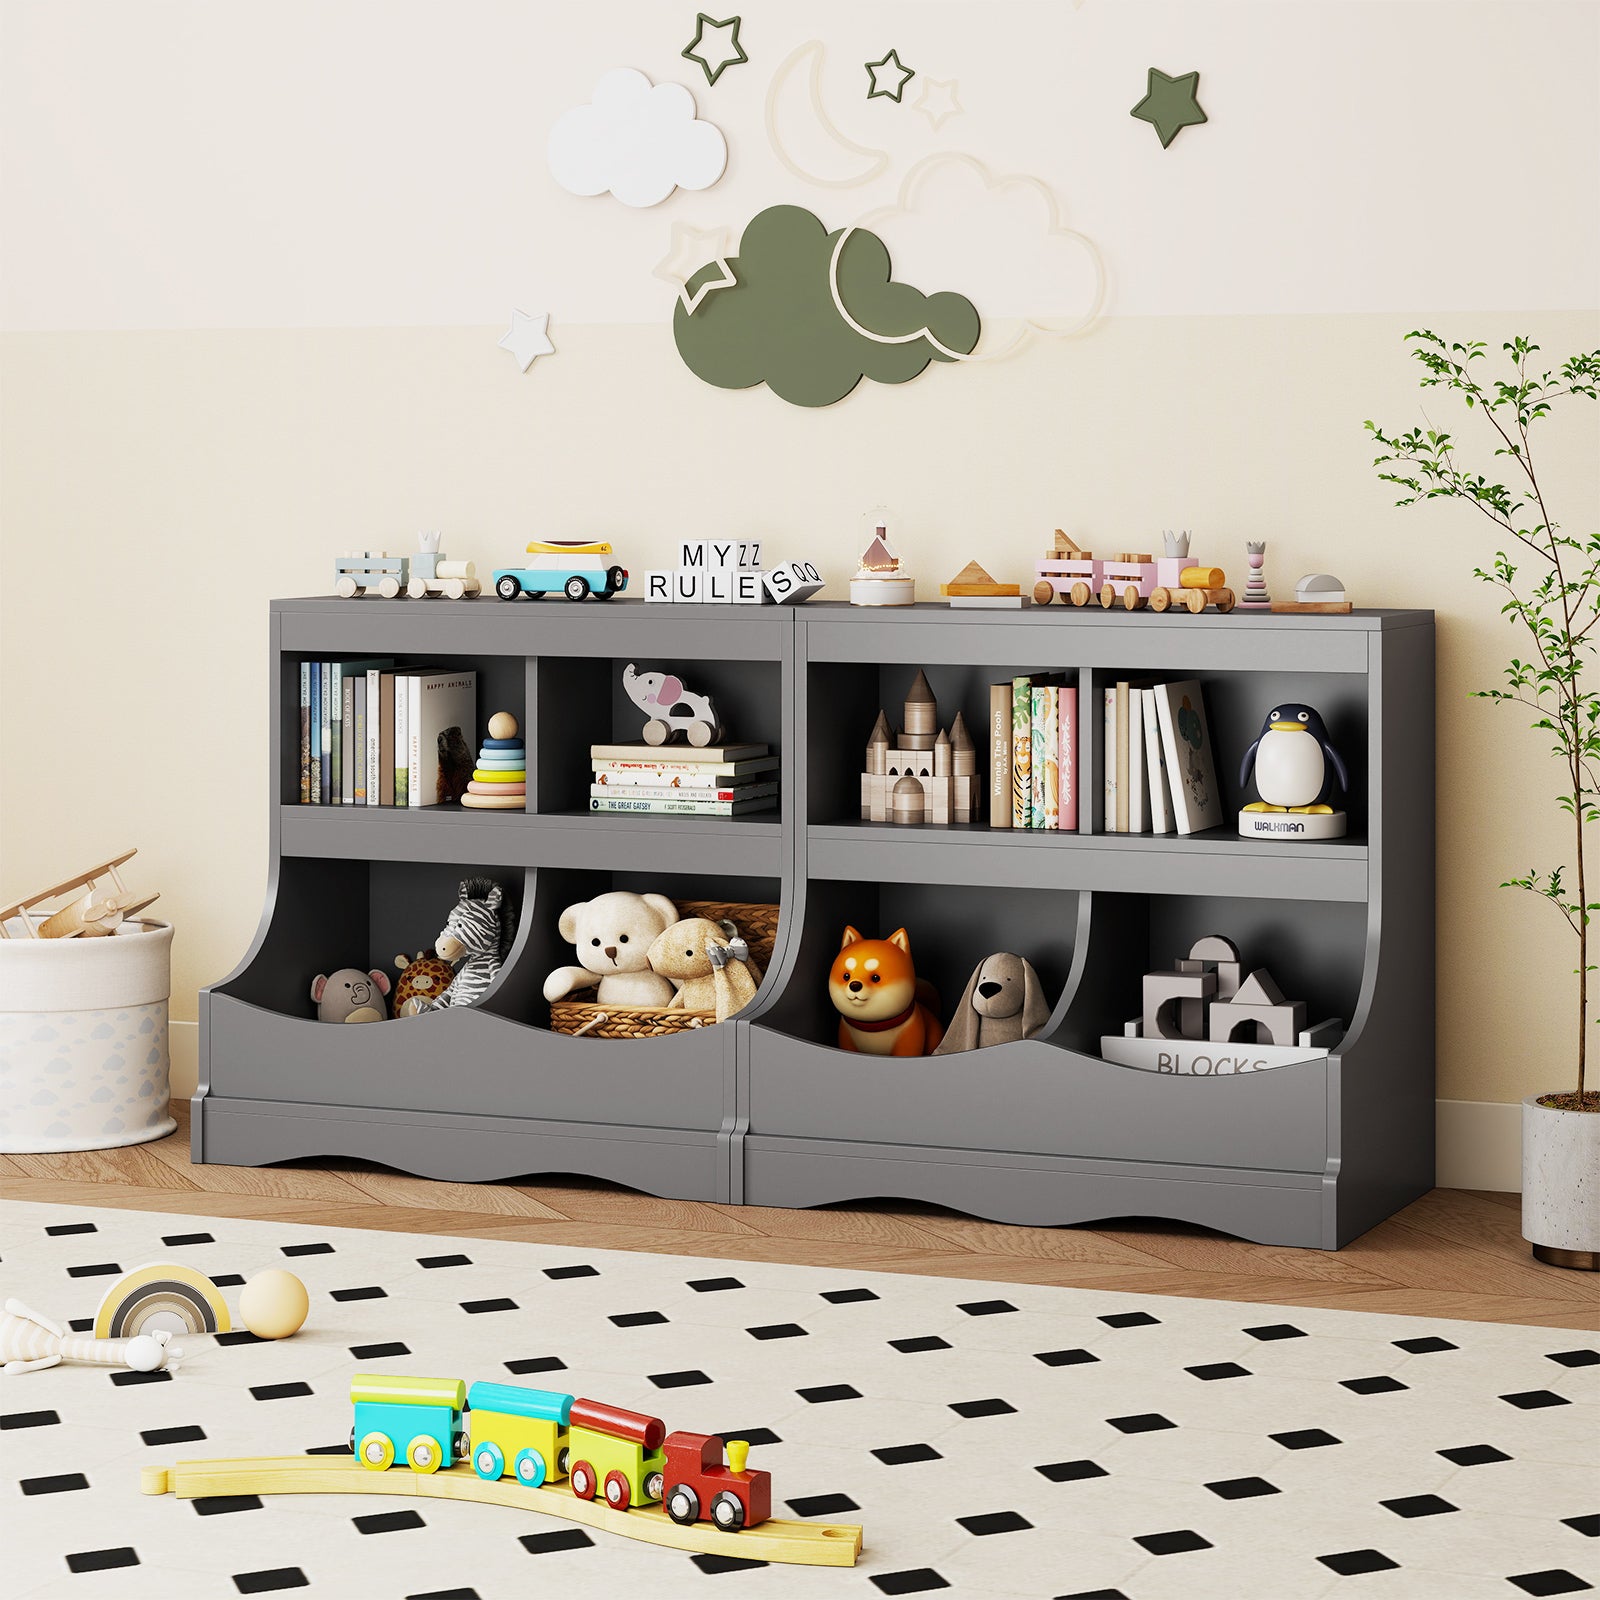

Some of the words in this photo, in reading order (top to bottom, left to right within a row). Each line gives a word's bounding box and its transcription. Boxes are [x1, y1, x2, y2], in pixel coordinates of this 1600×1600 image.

[683, 544, 731, 567] MY
[739, 544, 760, 567] ZZ
[791, 562, 822, 583] QQ
[448, 680, 472, 688] ANIMALS
[994, 710, 1002, 737] Pooh
[994, 739, 1002, 758] The
[994, 761, 1002, 796] Winnie
[608, 801, 617, 809] THE
[618, 801, 632, 810] GREAT
[633, 802, 651, 810] GATSBY
[1254, 821, 1305, 832] WALKMAN
